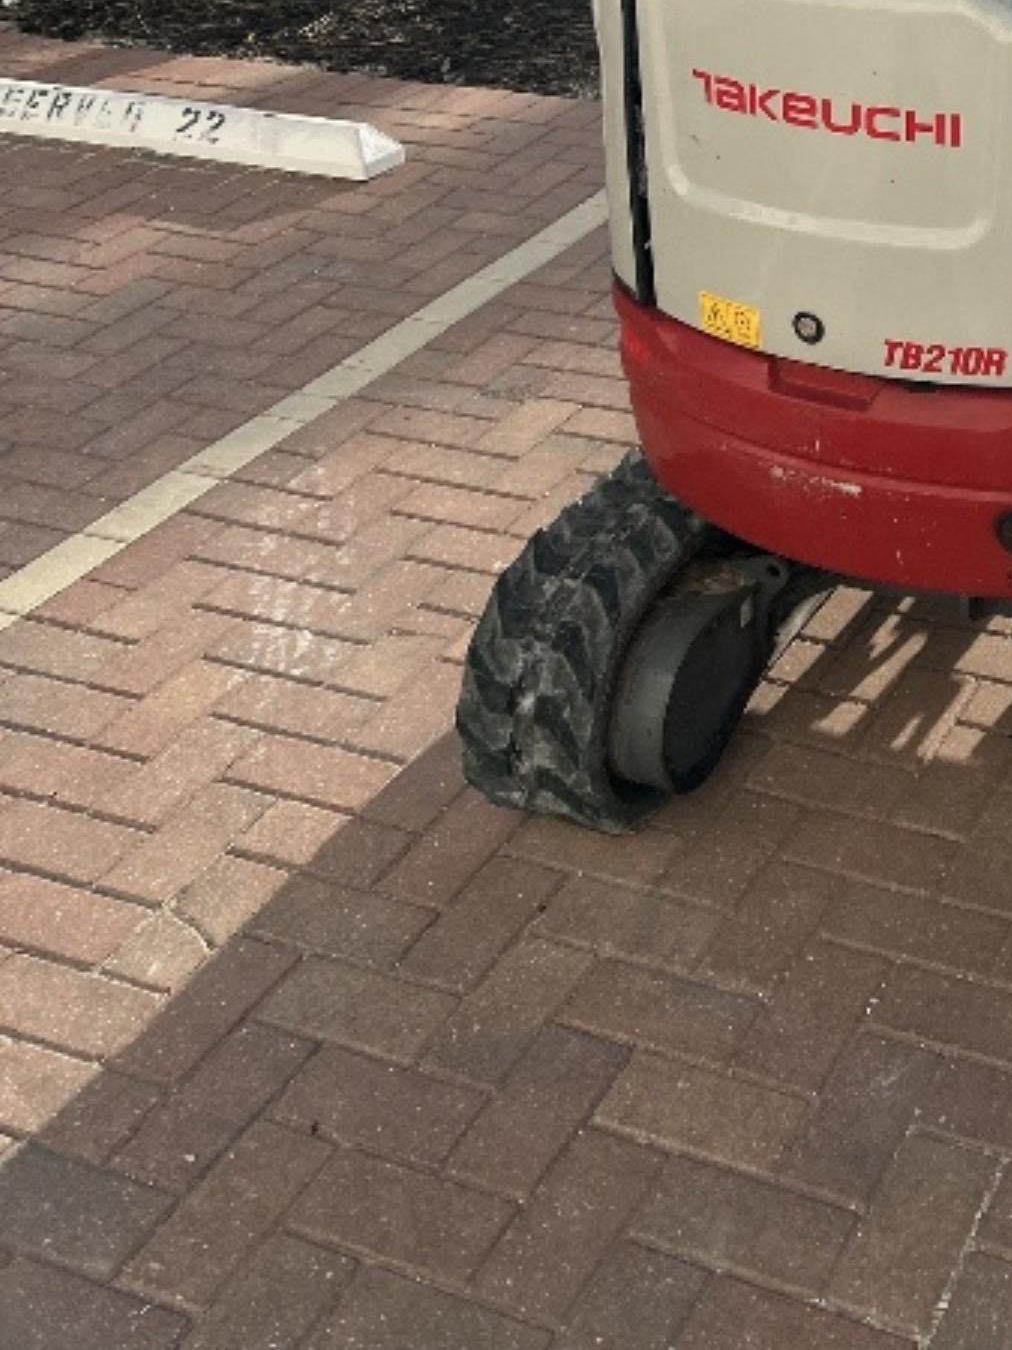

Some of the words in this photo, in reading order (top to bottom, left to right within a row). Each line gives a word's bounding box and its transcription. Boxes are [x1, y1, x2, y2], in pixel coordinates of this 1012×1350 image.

[174, 106, 227, 145] 22
[692, 68, 961, 147] TAKEUCHI
[884, 339, 1008, 377] TB210R
